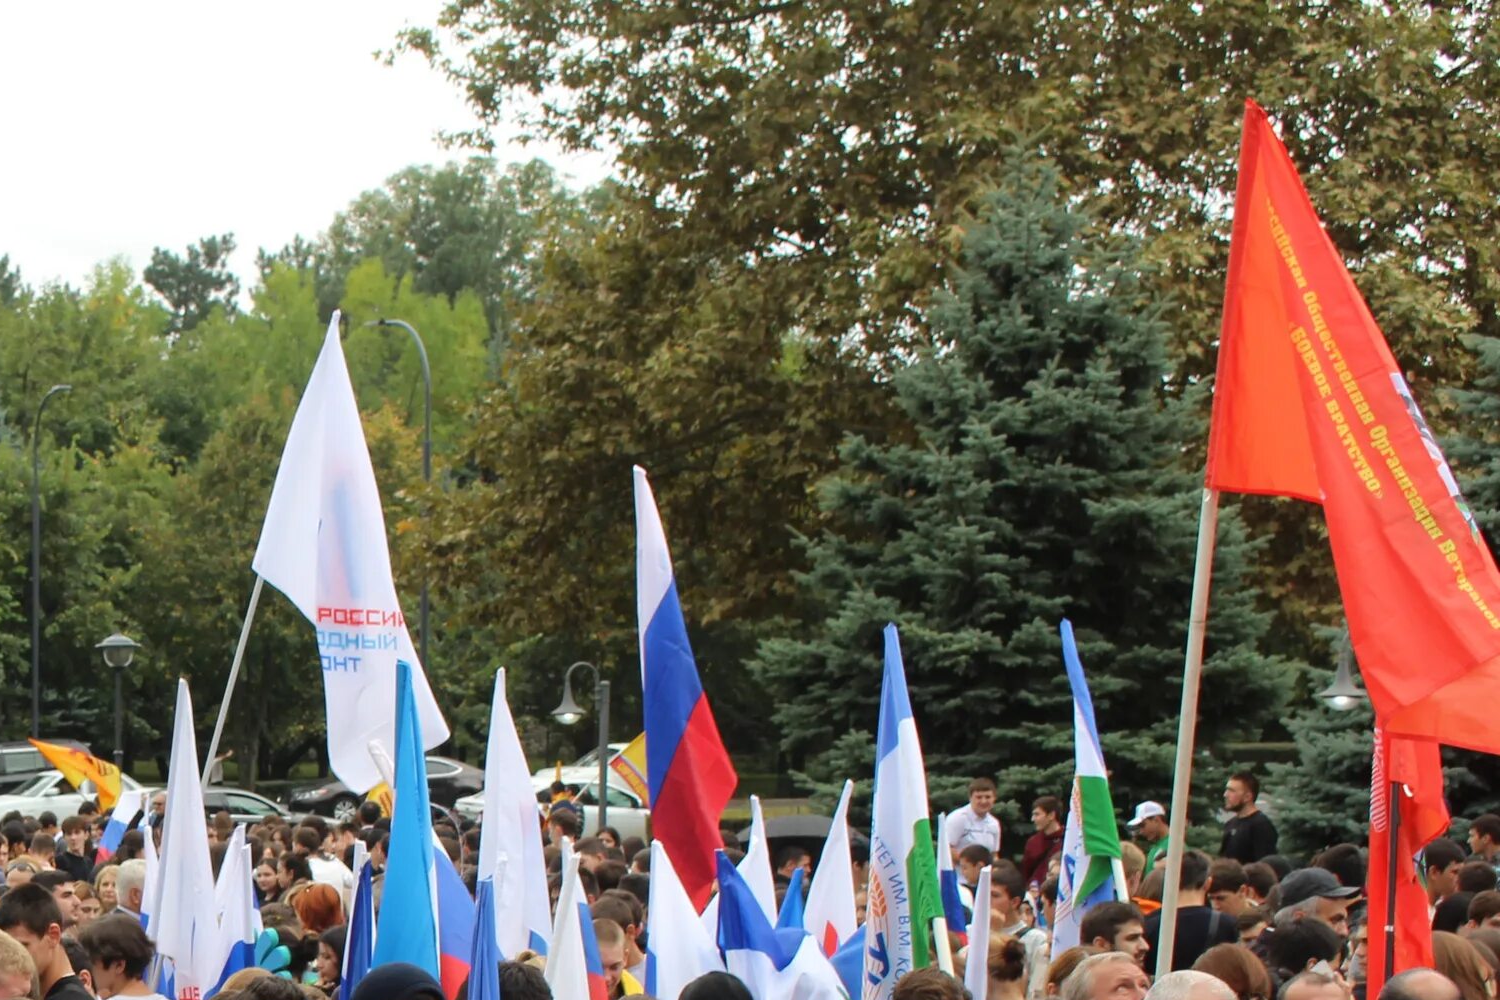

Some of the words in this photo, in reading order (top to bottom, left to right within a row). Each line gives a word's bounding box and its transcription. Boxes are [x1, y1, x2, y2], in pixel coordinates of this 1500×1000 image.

[1300, 289, 1374, 425] Общественная
[1367, 422, 1442, 541] Организация
[1324, 397, 1384, 500] БРАТСТВО»
